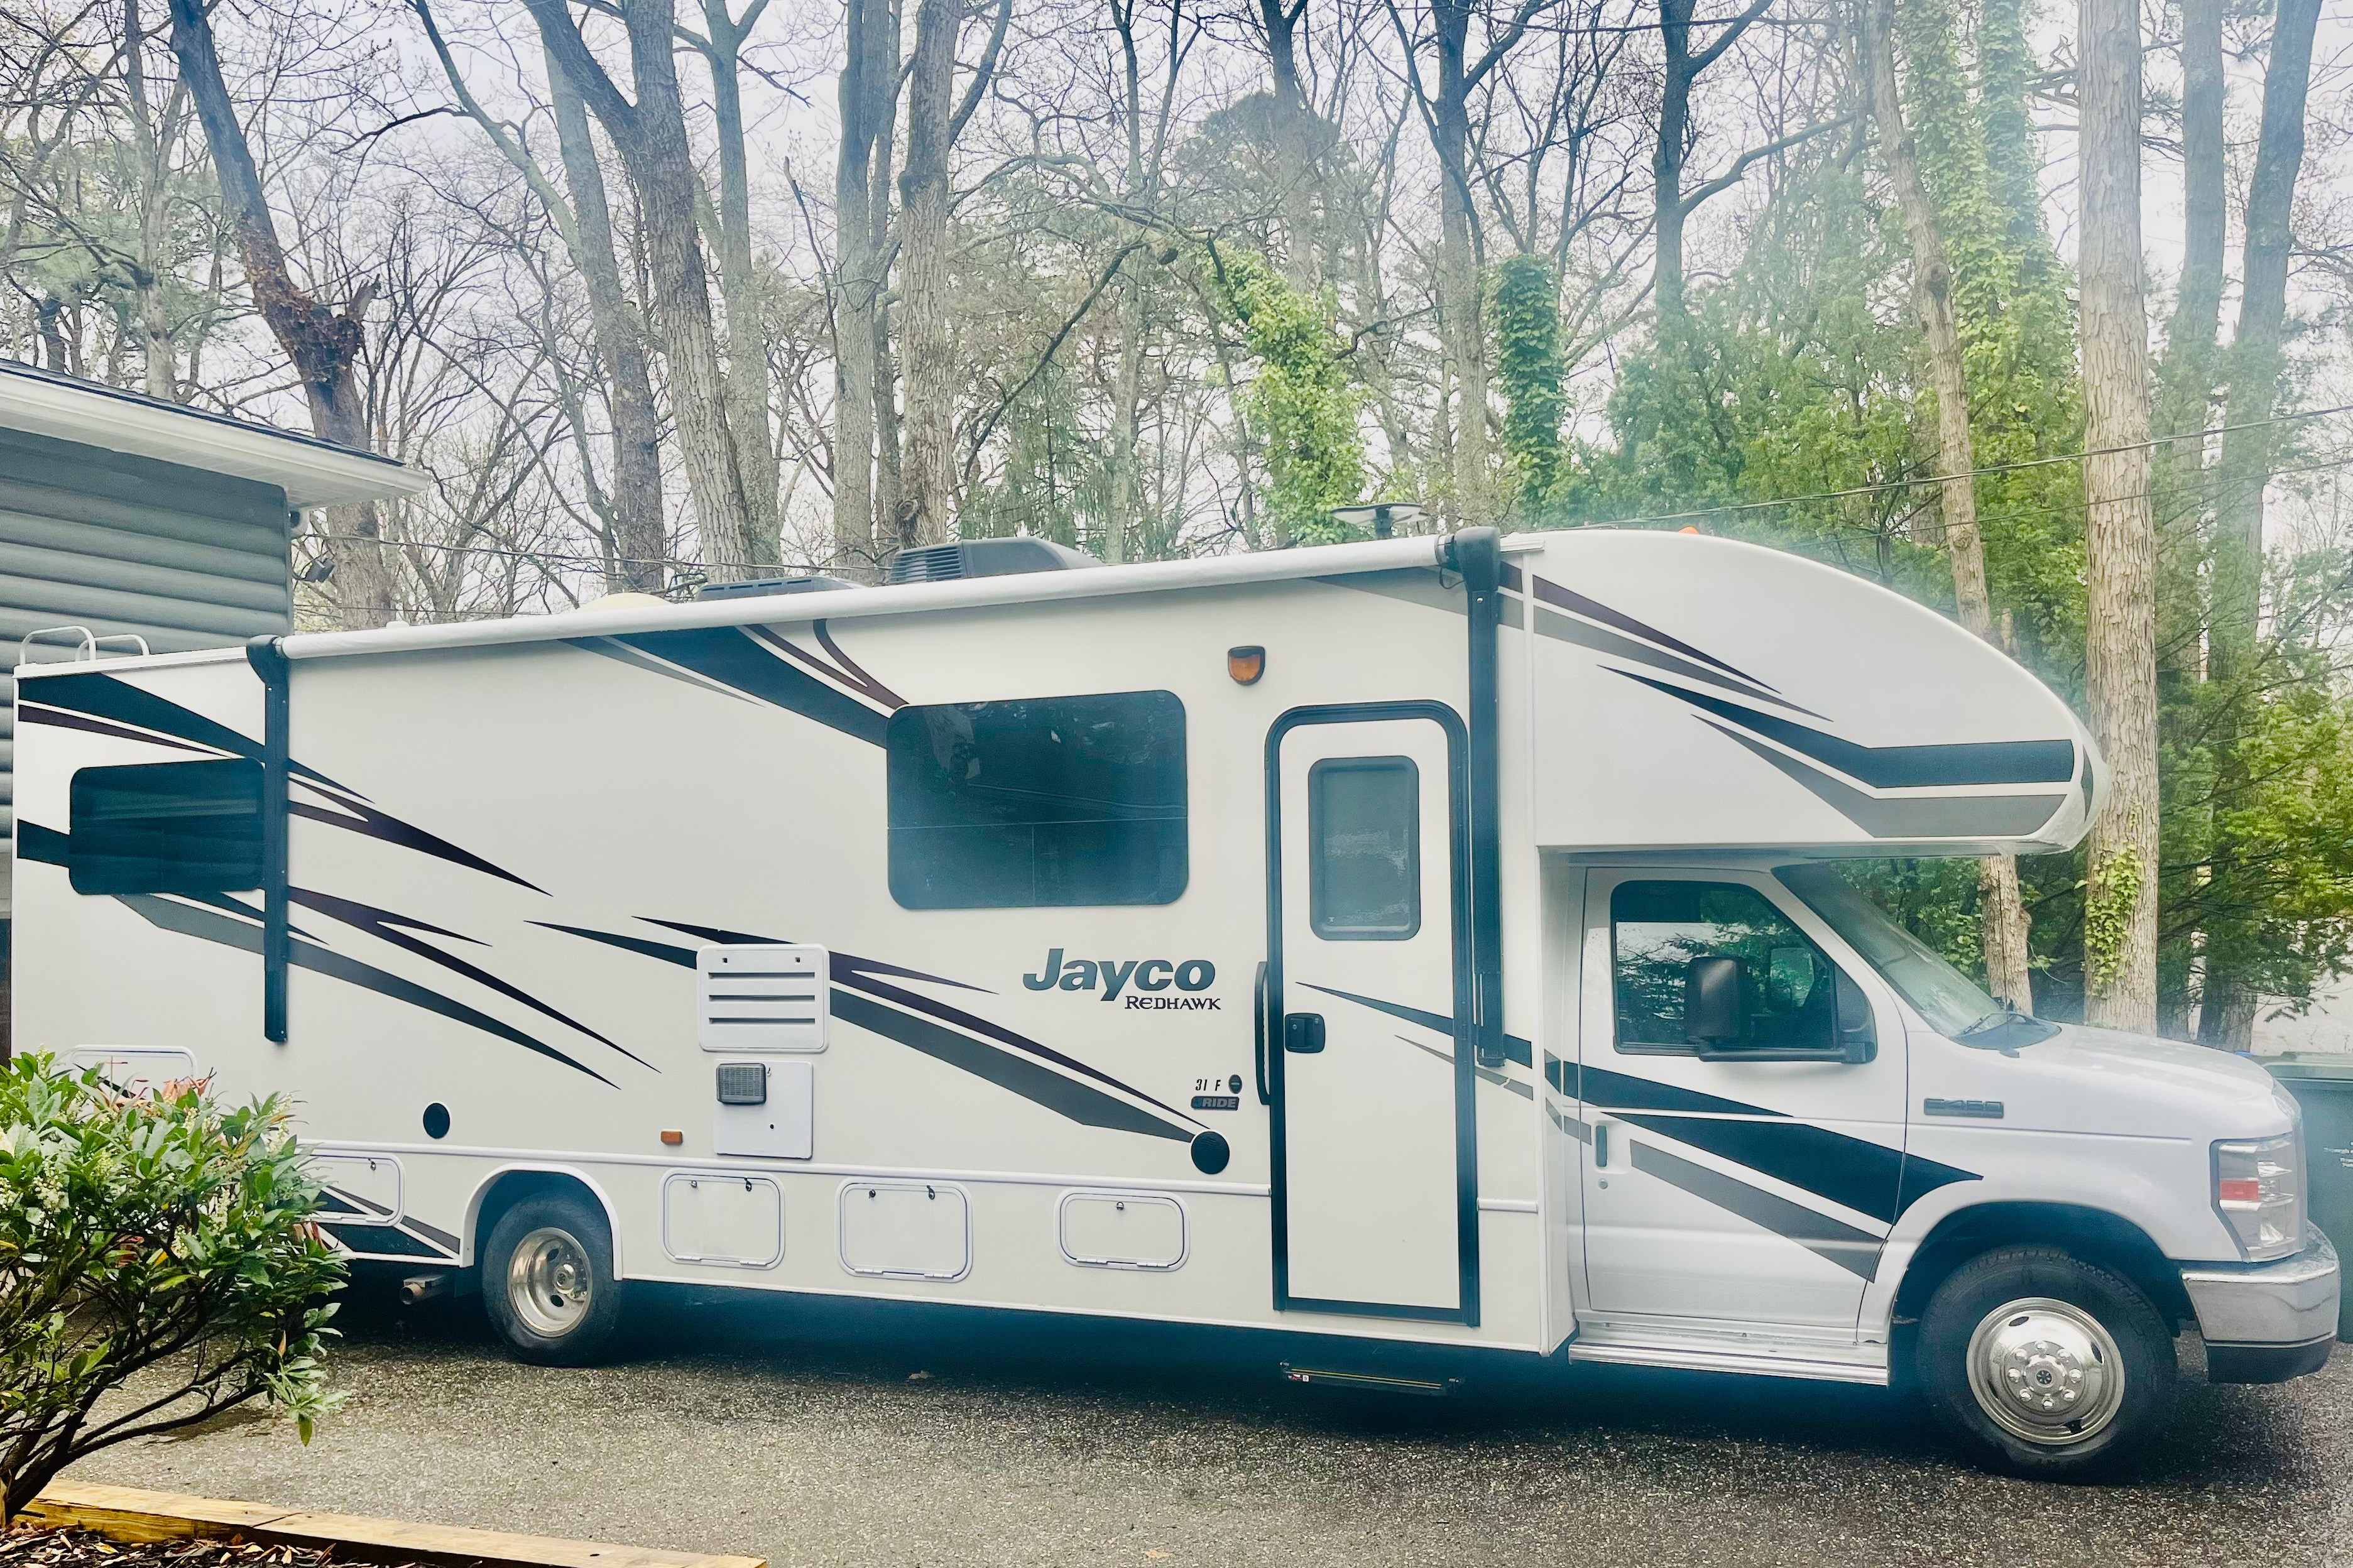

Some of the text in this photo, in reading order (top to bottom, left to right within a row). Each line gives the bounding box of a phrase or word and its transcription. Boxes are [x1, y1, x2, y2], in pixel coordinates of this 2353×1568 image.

[1022, 948, 1216, 1001] Jayco
[1124, 995, 1221, 1010] REDHAWK
[1195, 1079, 1221, 1091] 31 F
